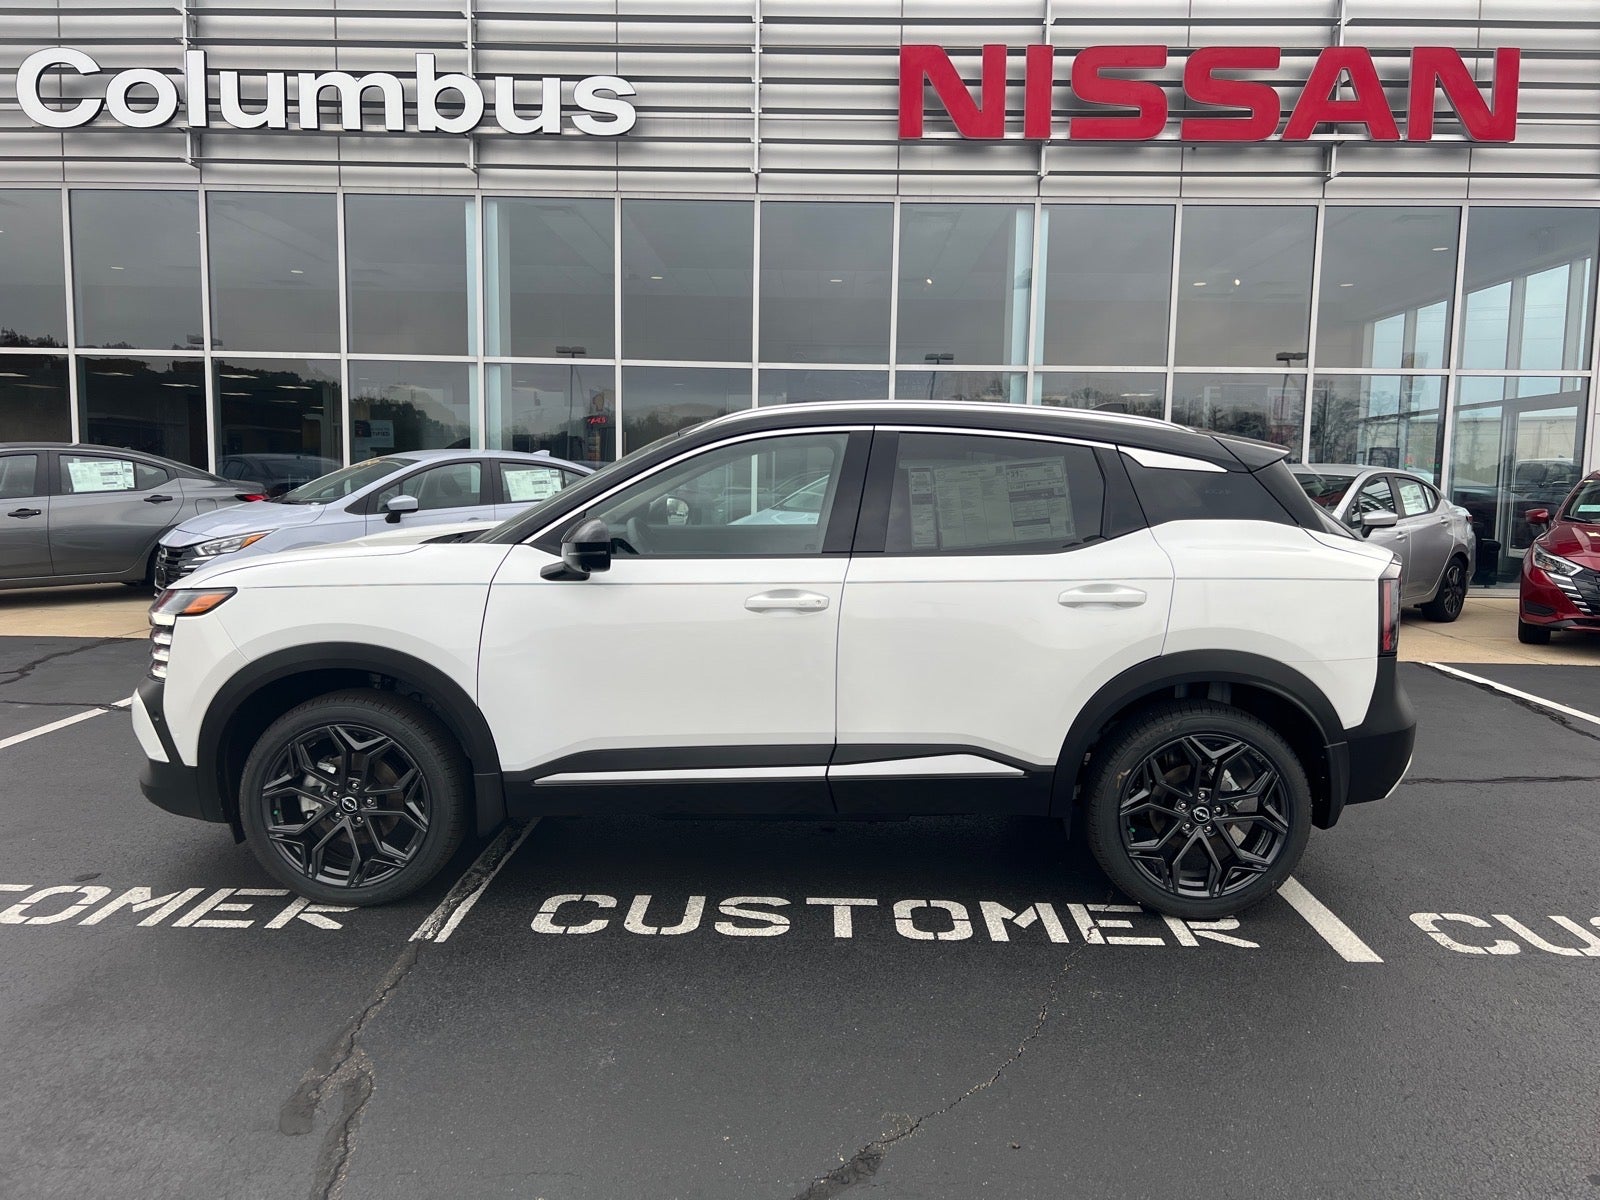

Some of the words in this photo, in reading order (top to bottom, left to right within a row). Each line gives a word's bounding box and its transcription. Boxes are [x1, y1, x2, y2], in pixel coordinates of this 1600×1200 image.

[16, 47, 638, 136] Columbus
[899, 44, 1521, 142] NISSAN
[531, 894, 1261, 948] CUSTOMER
[1409, 912, 1600, 957] CU
